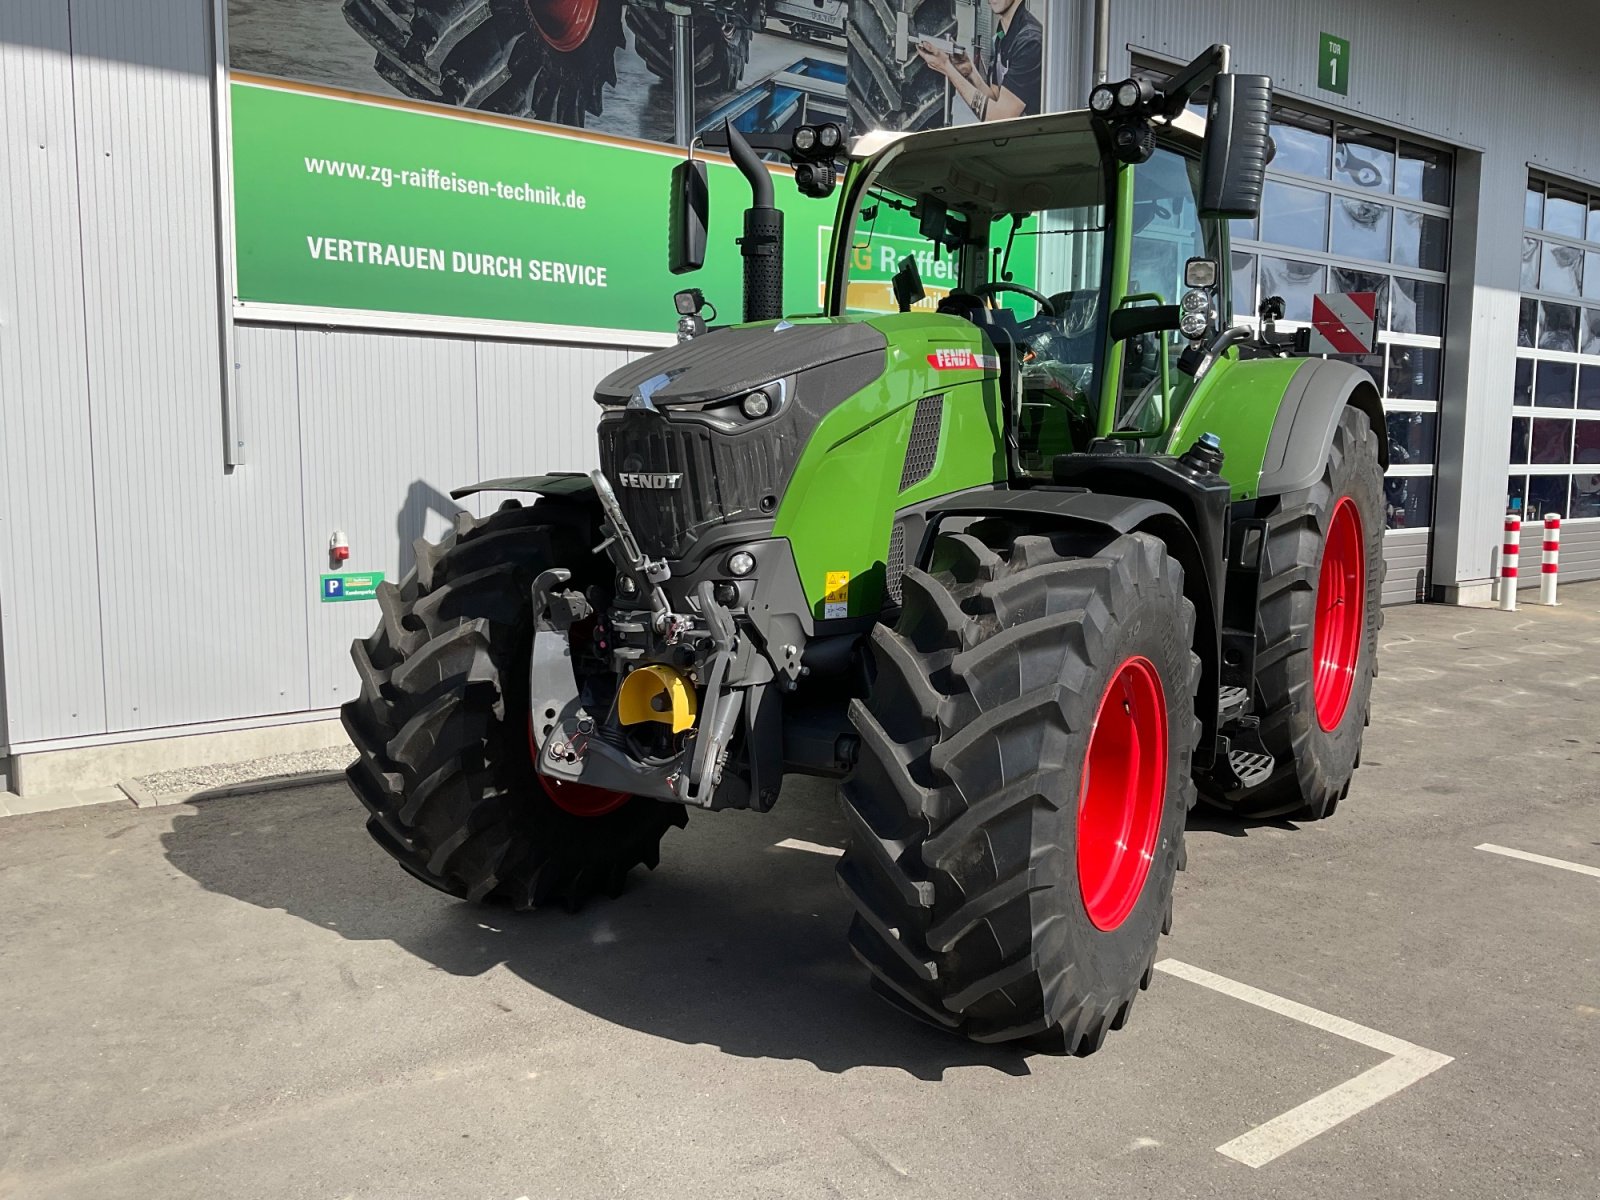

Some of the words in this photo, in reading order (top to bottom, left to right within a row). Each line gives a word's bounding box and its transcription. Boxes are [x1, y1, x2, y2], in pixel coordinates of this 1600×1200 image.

[1329, 41, 1341, 55] TOR
[1329, 58, 1337, 85] 1
[304, 157, 586, 209] www.zg-raiffeisen-technik.de
[307, 236, 445, 271] VERTRAUEN
[452, 251, 522, 279] DURCH
[529, 259, 607, 287] SERVICE
[849, 242, 872, 270] G
[936, 348, 971, 367] FENDT
[619, 473, 682, 489] FENDT
[329, 580, 339, 593] P
